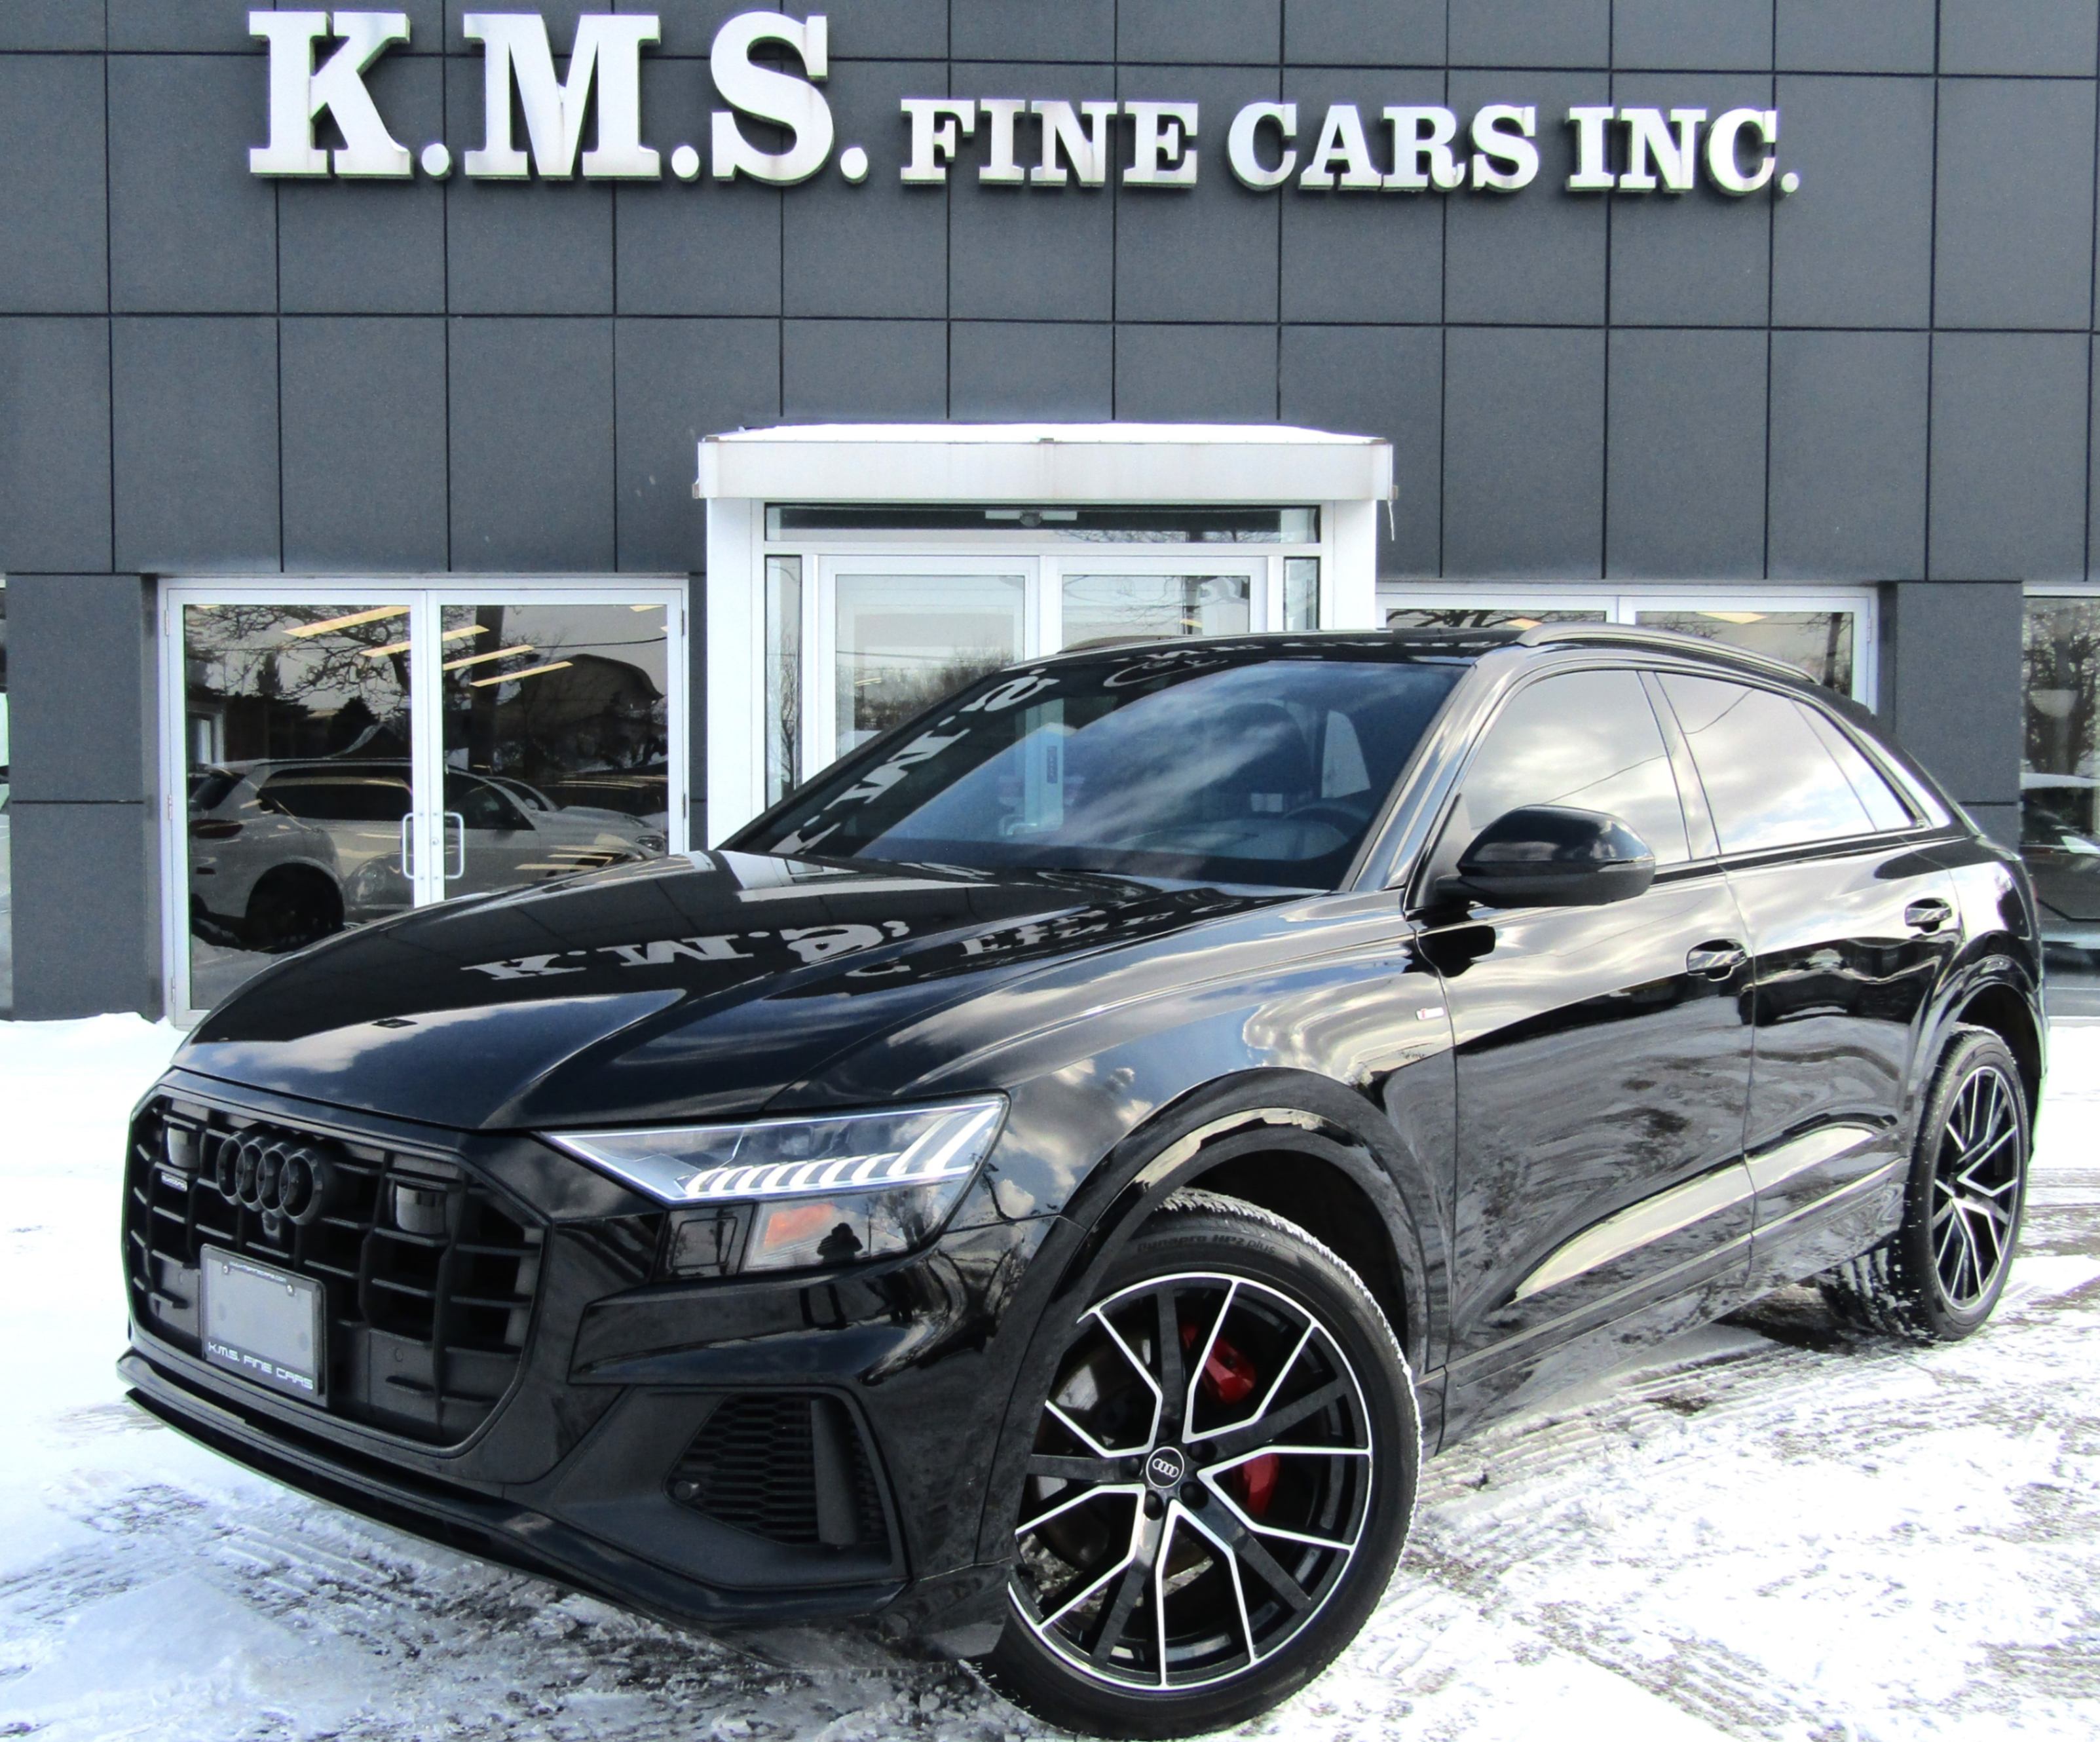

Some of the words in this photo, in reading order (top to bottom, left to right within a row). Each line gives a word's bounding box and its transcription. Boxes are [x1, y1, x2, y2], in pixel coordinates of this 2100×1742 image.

[249, 11, 869, 185] K.M.S.
[900, 98, 1199, 186] FINE
[1228, 102, 1539, 191] CARS
[1568, 106, 1801, 195] INC.
[1247, 1240, 1277, 1255] plus
[243, 1354, 272, 1374] FINE
[276, 1367, 313, 1390] CARS
